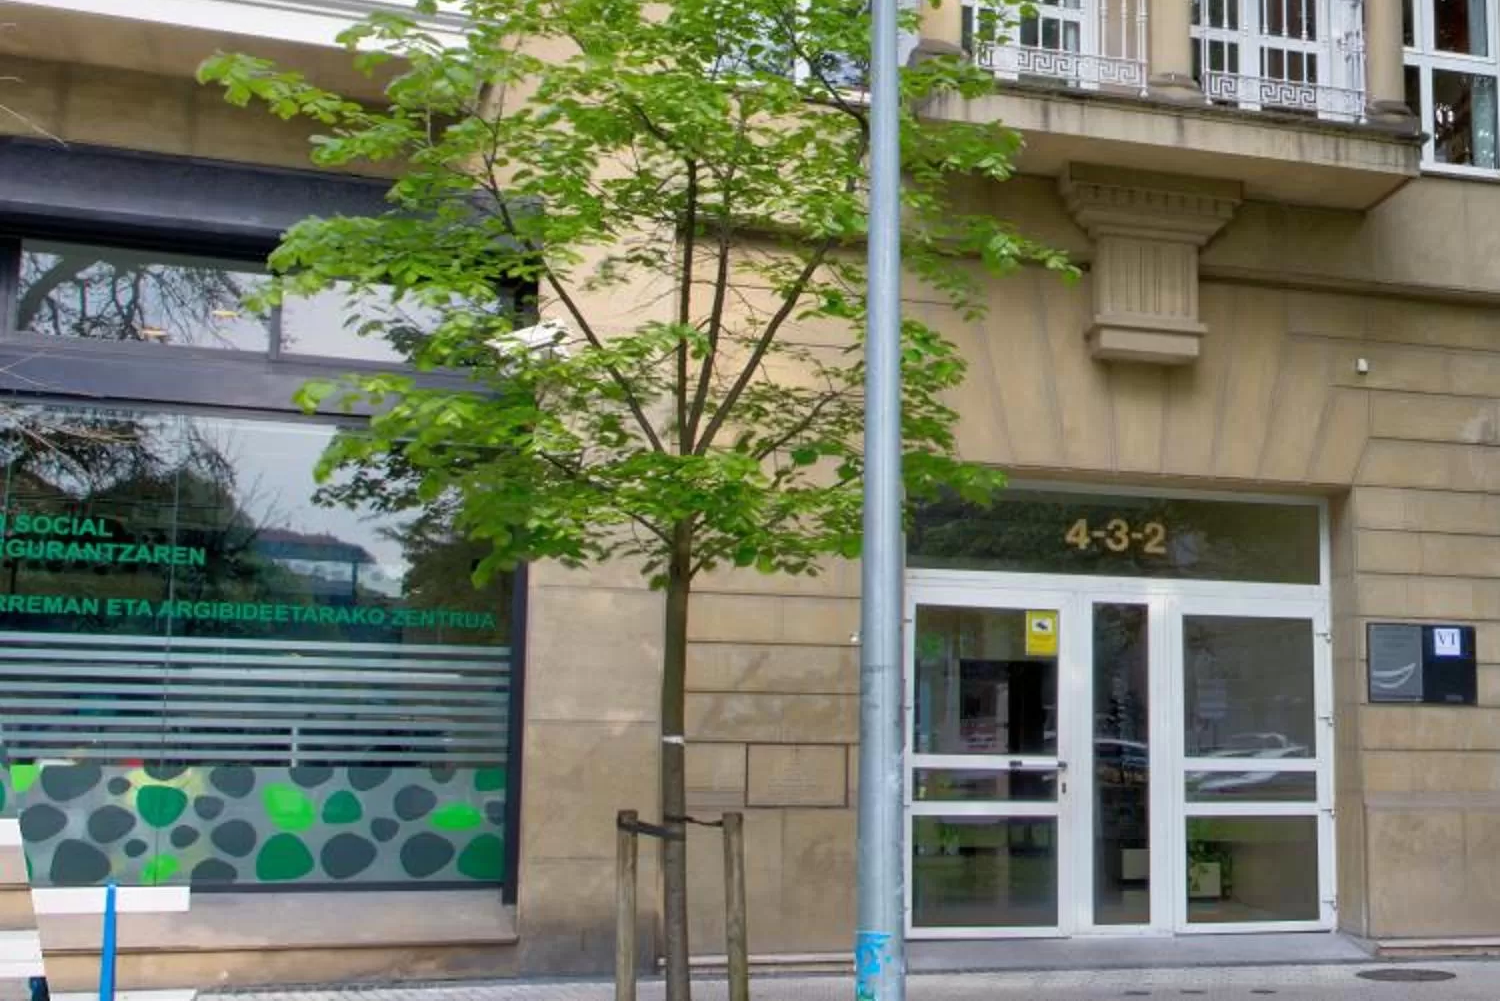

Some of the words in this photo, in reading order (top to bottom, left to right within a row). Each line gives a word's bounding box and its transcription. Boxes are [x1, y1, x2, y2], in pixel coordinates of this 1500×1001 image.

[14, 515, 113, 537] SOCIAL
[1065, 518, 1167, 554] 4-3-2
[0, 538, 206, 566] GURANTZAREN
[106, 598, 153, 617] ETA
[157, 600, 386, 626] ARGIBIDEETARAKO
[390, 609, 496, 629] ZENTRUA
